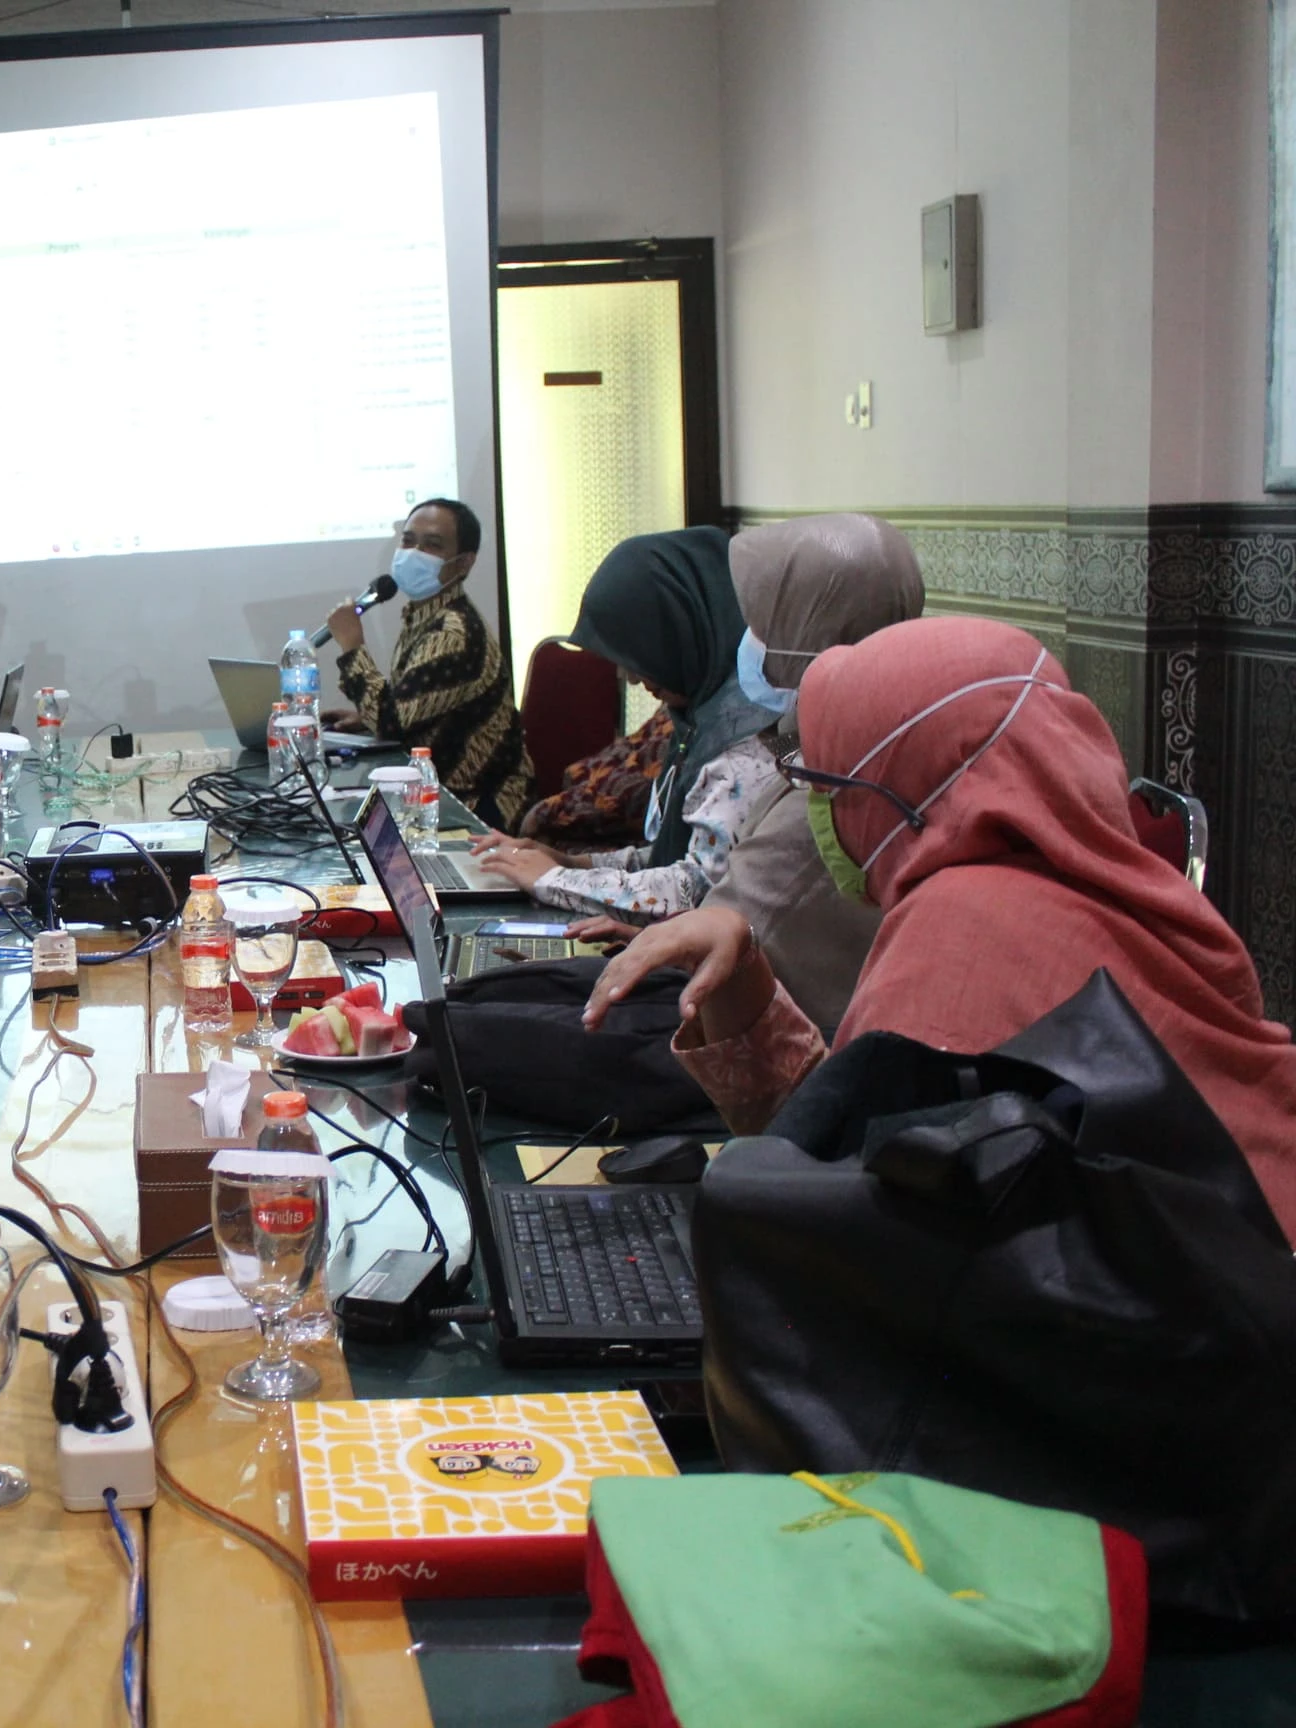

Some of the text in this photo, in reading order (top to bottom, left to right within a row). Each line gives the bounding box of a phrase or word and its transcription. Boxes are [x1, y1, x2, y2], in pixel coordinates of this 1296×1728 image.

[427, 1440, 534, 1452] HokBen
[335, 1560, 438, 1581] ほかべん
